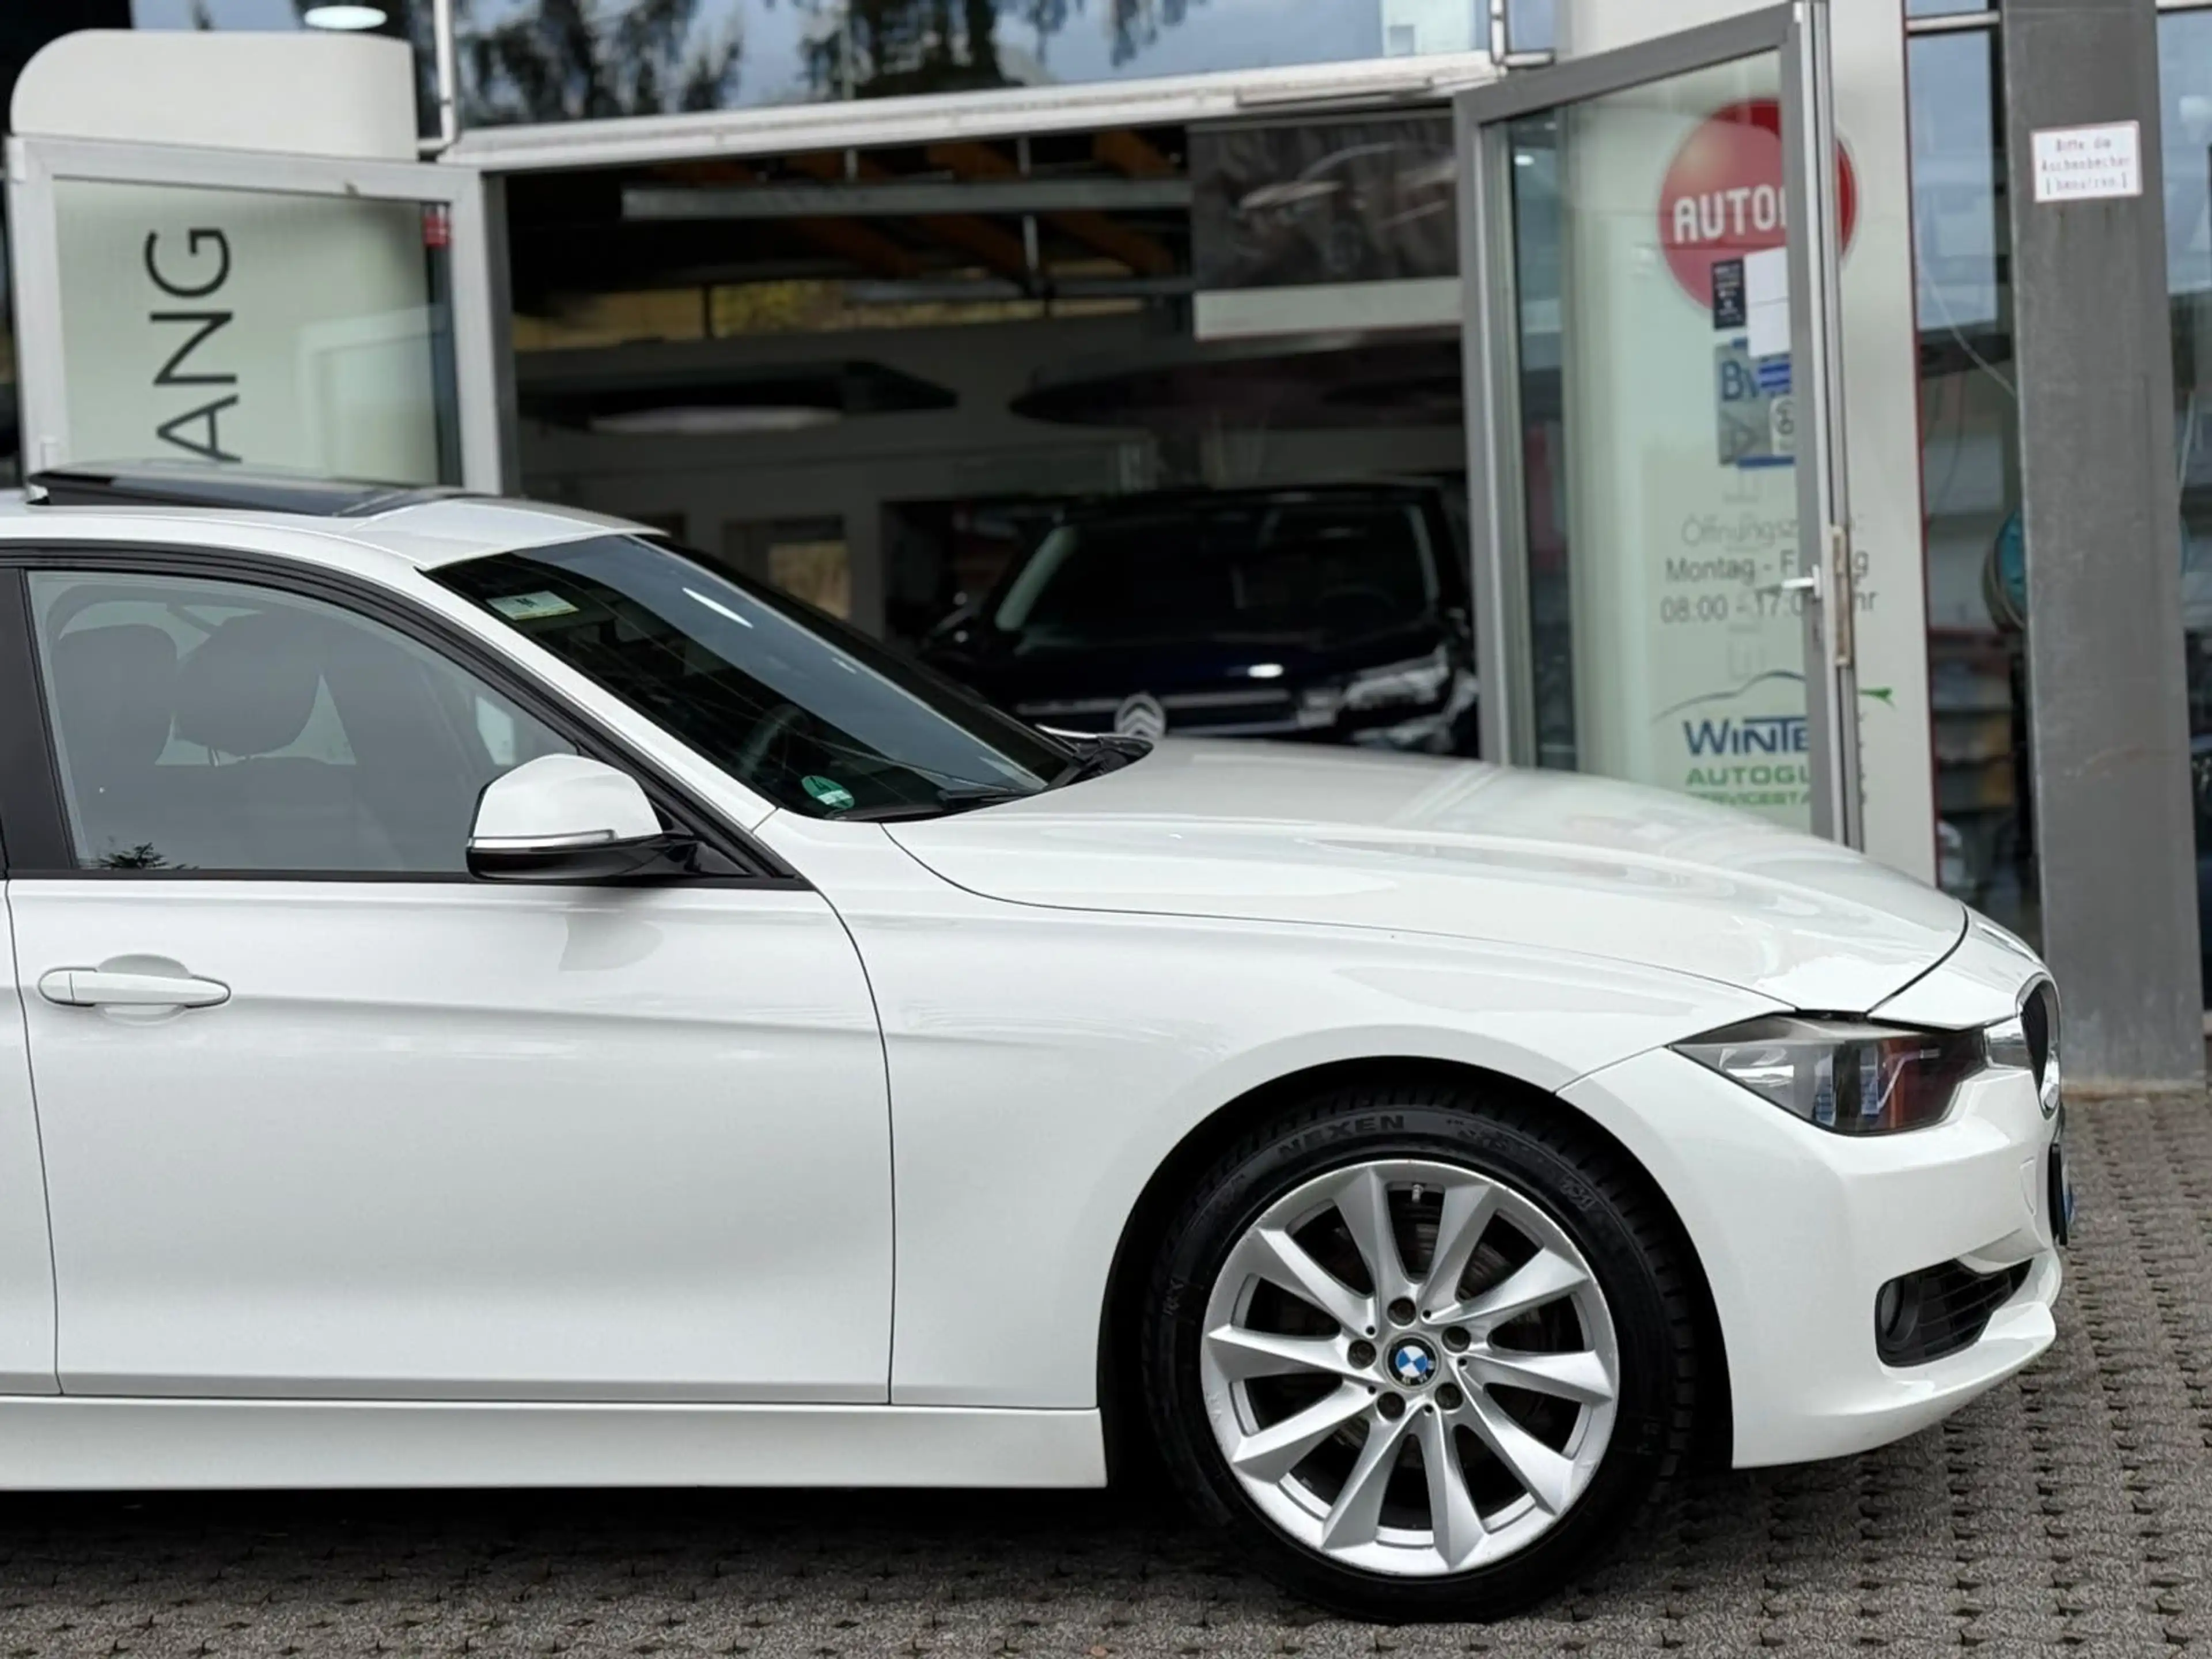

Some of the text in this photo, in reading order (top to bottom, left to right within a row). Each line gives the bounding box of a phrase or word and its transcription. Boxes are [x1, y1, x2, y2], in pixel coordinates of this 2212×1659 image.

[1673, 183, 1786, 244] AUTO
[1666, 556, 1755, 586] Montag
[1277, 1114, 1404, 1159] NEXEN
